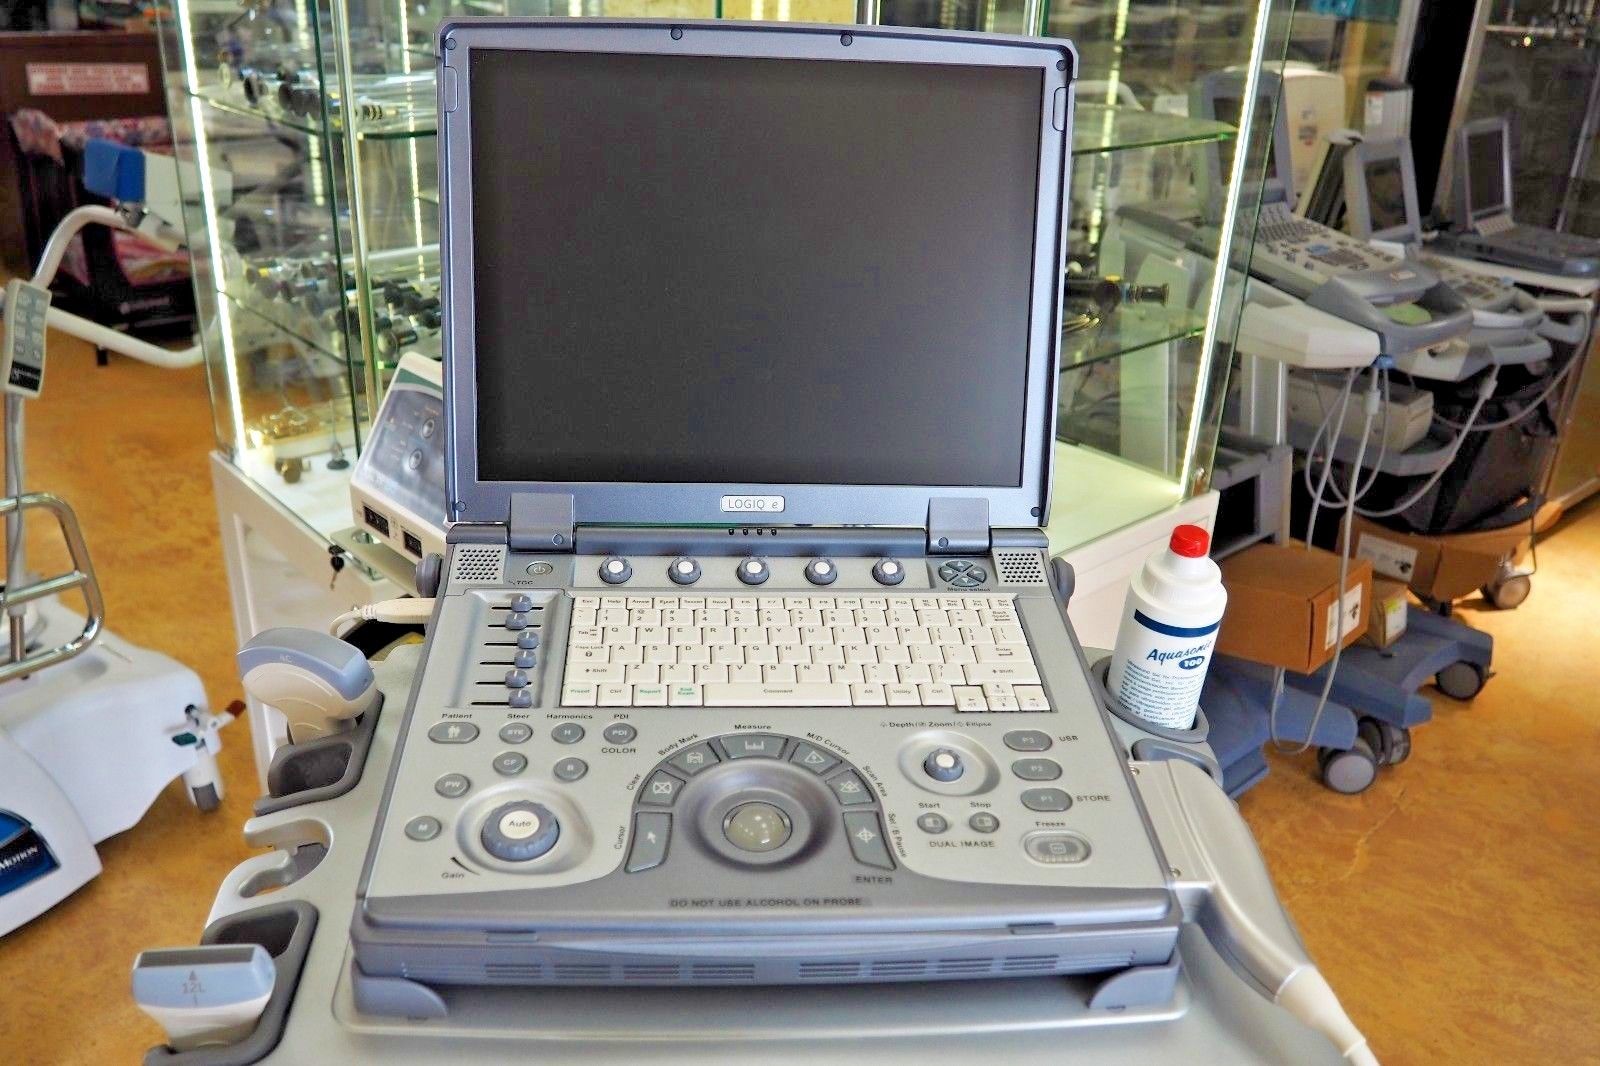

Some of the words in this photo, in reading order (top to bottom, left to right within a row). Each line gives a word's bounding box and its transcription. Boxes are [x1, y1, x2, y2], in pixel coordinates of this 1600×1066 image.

[728, 499, 765, 510] LOGIQ
[771, 501, 778, 509] e
[1184, 657, 1203, 667] 100
[658, 742, 678, 756] Body
[678, 733, 698, 744] Mark
[807, 732, 823, 742] M/D
[824, 737, 851, 755] Cursor
[862, 765, 878, 782] Scan
[626, 774, 641, 791] Clear
[1076, 794, 1111, 802] STORE
[614, 826, 625, 850] Cursor
[929, 840, 956, 848] DUAL
[960, 840, 995, 848] IMAGE
[441, 871, 465, 879] Gain
[856, 876, 893, 884] ENTER
[670, 900, 688, 908] DO
[691, 899, 714, 908] NOT
[719, 899, 741, 908] USE
[745, 899, 799, 907] ALCOHOL
[803, 898, 820, 906] ON
[823, 898, 862, 906] PROBE
